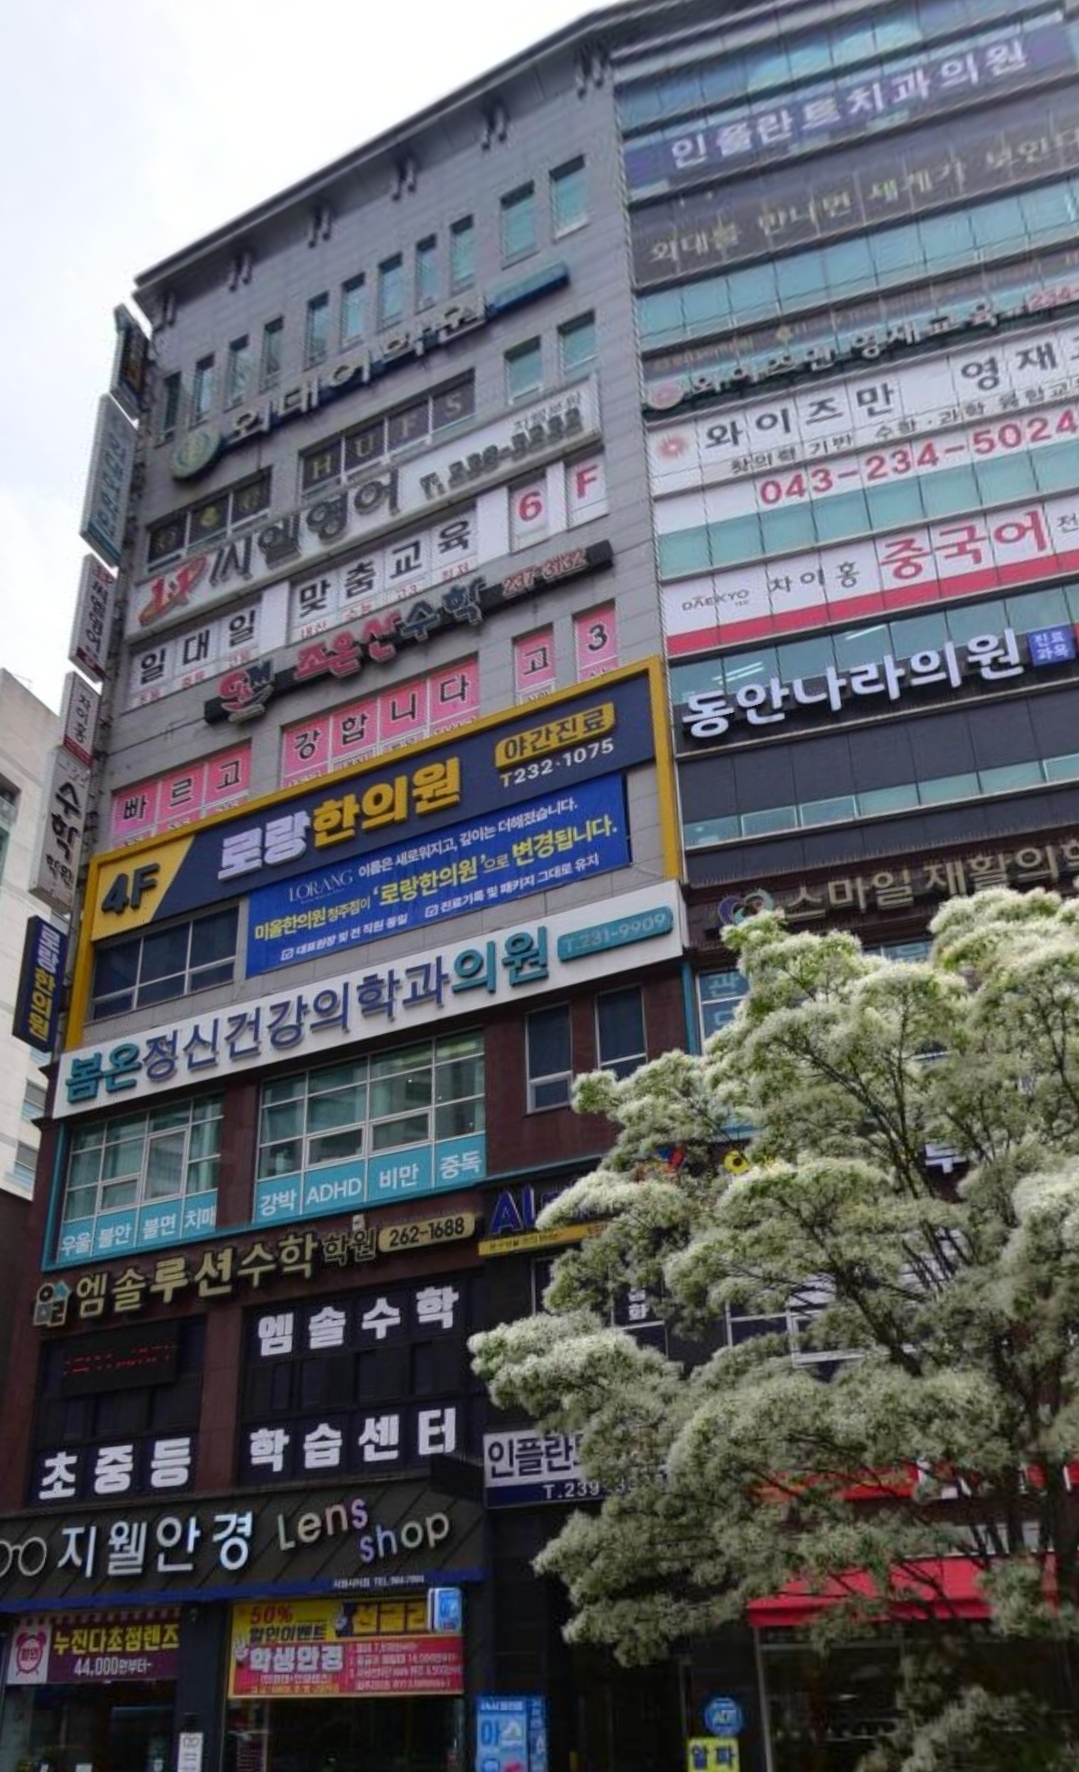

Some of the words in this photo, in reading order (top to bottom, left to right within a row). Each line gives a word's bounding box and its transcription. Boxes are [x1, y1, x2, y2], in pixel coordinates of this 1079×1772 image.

[671, 38, 1028, 170] 인플란트치과의원
[705, 381, 895, 450] 와이즈만
[759, 409, 1078, 505] 043-234-5024
[770, 561, 860, 593] 차이홍
[880, 508, 1048, 580] 중국어
[141, 609, 255, 685] 일대일
[301, 519, 470, 618] 맞춤교육
[683, 627, 1024, 738] 동안나라의원
[124, 760, 240, 820] 빠르고
[295, 673, 470, 761] 강합니다
[503, 708, 605, 760] 야간진료
[51, 781, 82, 863] 수학
[217, 757, 461, 881] 로랑한의원
[459, 825, 497, 846] 깊이는
[511, 813, 619, 867] 변경됩니다.
[101, 862, 161, 917] 4F
[537, 862, 574, 884] 그대로
[574, 852, 600, 872] 유지
[61, 1231, 92, 1257] 우울
[98, 1222, 133, 1249] 불안
[142, 1212, 177, 1241] 불면
[184, 1204, 217, 1230] 치매
[259, 1188, 297, 1217] 강박
[306, 1177, 363, 1205] ADHD
[378, 1163, 420, 1190] 비만
[439, 1149, 482, 1181] 중독
[76, 1232, 318, 1319] 엠솔루션수학
[323, 1226, 378, 1267] 학원
[388, 1215, 466, 1249] 262-1688
[38, 1437, 192, 1500] 초중등
[250, 1407, 457, 1473] 학습센터
[58, 1510, 254, 1578] 지웰안경
[277, 1498, 368, 1551] Lens
[358, 1512, 450, 1563] shop
[54, 1623, 180, 1657] 누진다초점렌즈
[250, 1605, 293, 1624] 50%
[249, 1645, 344, 1674] 학생안경
